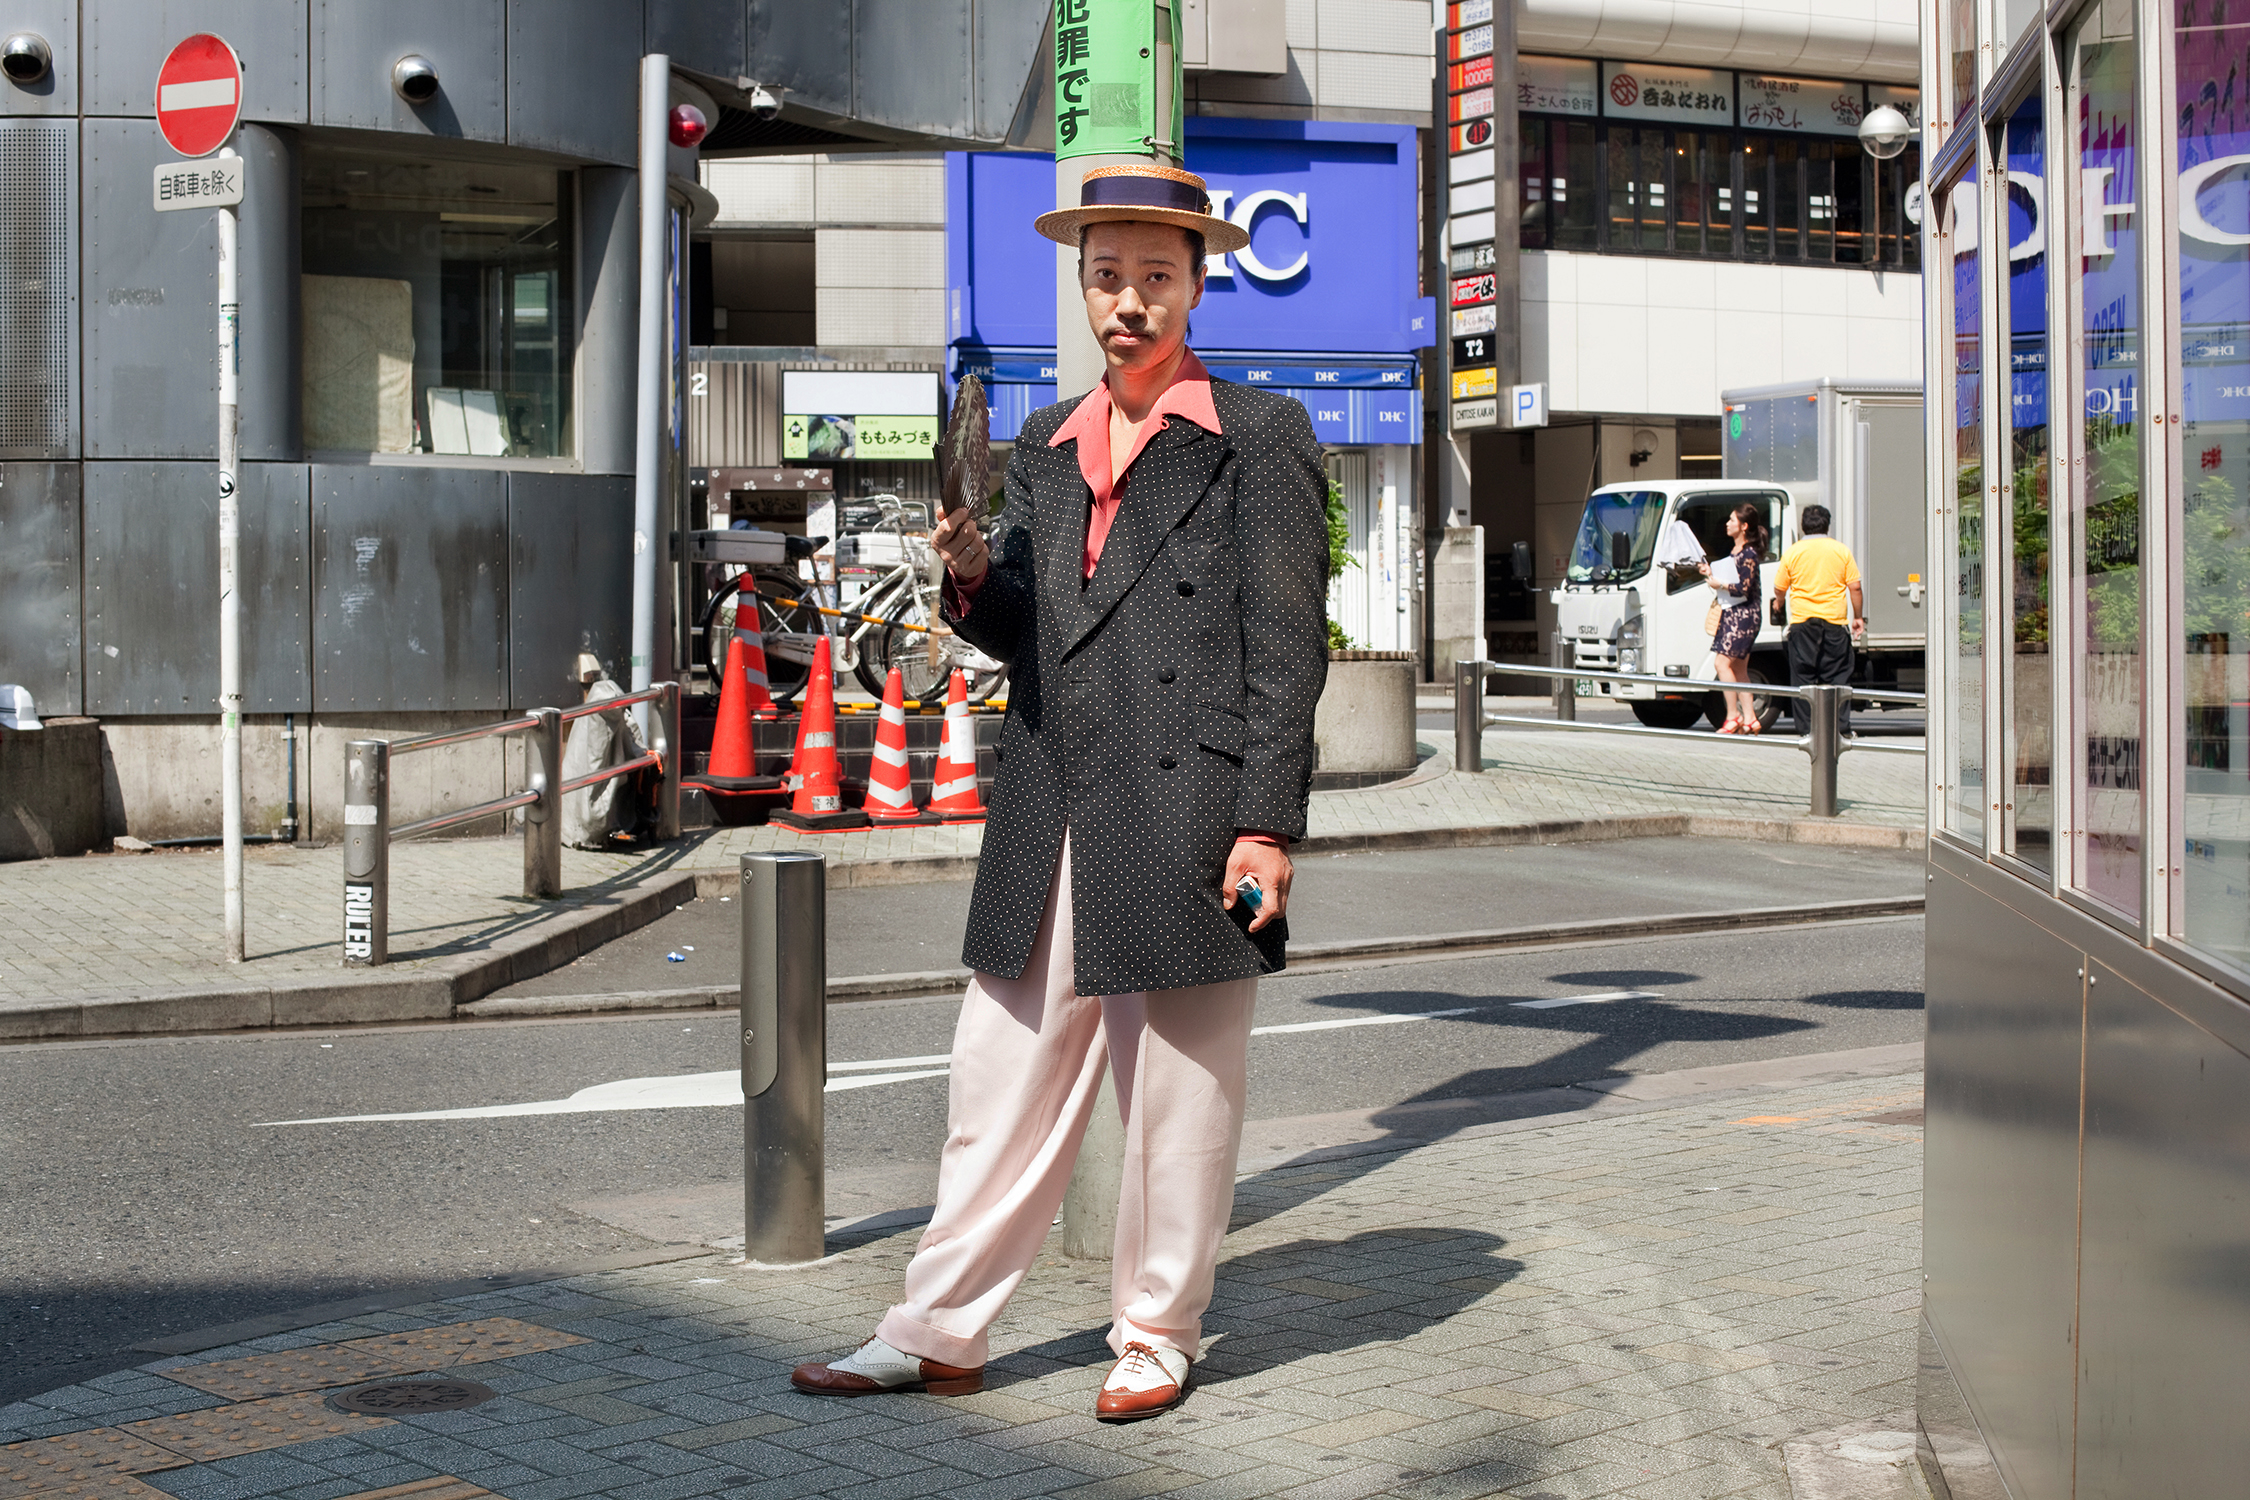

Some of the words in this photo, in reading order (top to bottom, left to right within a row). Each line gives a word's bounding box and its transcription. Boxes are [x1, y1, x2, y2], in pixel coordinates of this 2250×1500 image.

[1464, 68, 1493, 87] 1000円
[1643, 88, 1727, 111] 呑みだおれ
[1469, 122, 1488, 143] 4F
[160, 169, 235, 201] 自転車を除く
[1412, 317, 1424, 331] DHC
[2092, 294, 2125, 370] OPEN
[1465, 339, 1484, 357] T2
[971, 366, 996, 377] DHC
[1248, 371, 1272, 381] DHC
[1315, 372, 1339, 382] DHC
[1382, 373, 1406, 383] DHC
[691, 373, 708, 395] 2
[1456, 408, 1476, 420] CHITOSE
[1477, 406, 1495, 418] KAIKAN
[1518, 391, 1534, 421] P
[1318, 411, 1345, 421] DHC
[1379, 412, 1406, 422] DHC
[860, 430, 932, 445] ももみづき
[861, 477, 874, 487] KN
[896, 477, 904, 489] 2
[1578, 626, 1598, 634] ISUZU
[345, 886, 372, 958] RULER
